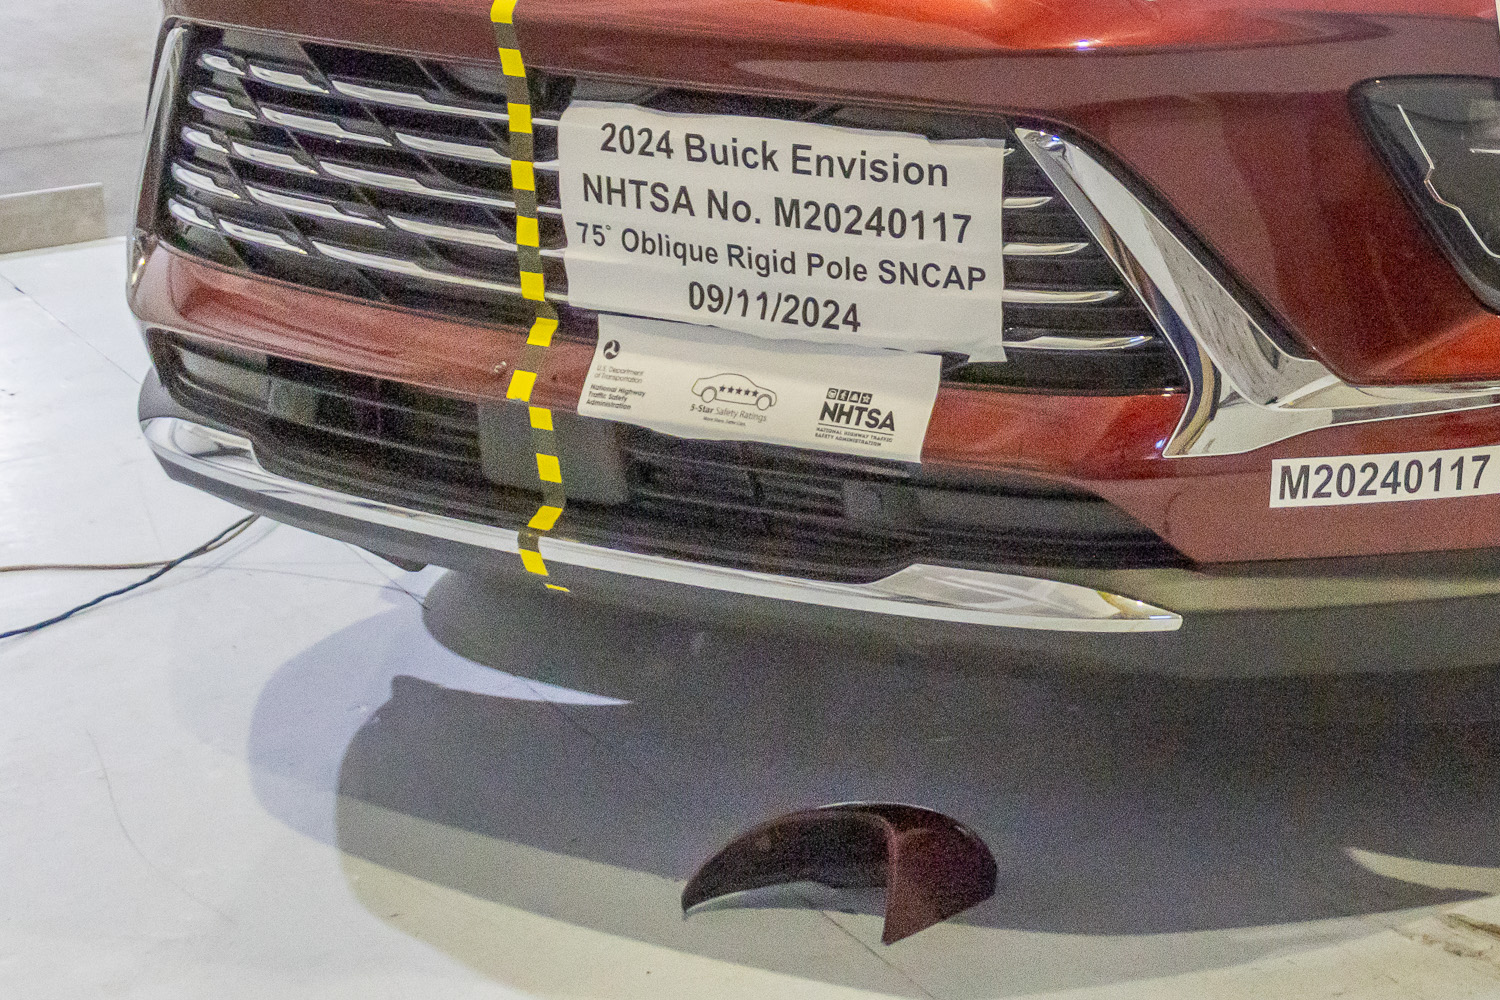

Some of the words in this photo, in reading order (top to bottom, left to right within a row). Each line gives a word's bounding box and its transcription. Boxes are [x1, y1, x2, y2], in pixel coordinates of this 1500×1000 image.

[600, 122, 674, 160] 2024
[685, 132, 779, 173] Buick
[791, 143, 949, 187] Envision
[582, 172, 695, 217] NHTSA
[706, 188, 761, 225] No.
[774, 196, 972, 244] M20240117
[621, 228, 719, 266] Oblique
[727, 243, 796, 277] Rigid
[807, 252, 867, 282] Pole
[878, 260, 986, 291] SNCAP
[688, 280, 861, 333] 09/11/2024
[609, 366, 644, 376] Department
[591, 384, 617, 393] National
[618, 387, 646, 397] Highway
[608, 393, 627, 403] Safety
[586, 399, 632, 410] Administration
[690, 403, 714, 414] 5-Star
[716, 407, 739, 419] Safety
[740, 410, 767, 424] Ratings
[819, 401, 895, 431] NHTSA
[815, 432, 834, 440] SAFETY
[835, 435, 881, 447] ADMINISTRATION
[816, 427, 842, 436] NATIONAL
[844, 431, 869, 439] HIGHWAY
[871, 434, 893, 443] TRAFFIC
[1279, 454, 1491, 500] M20240117
